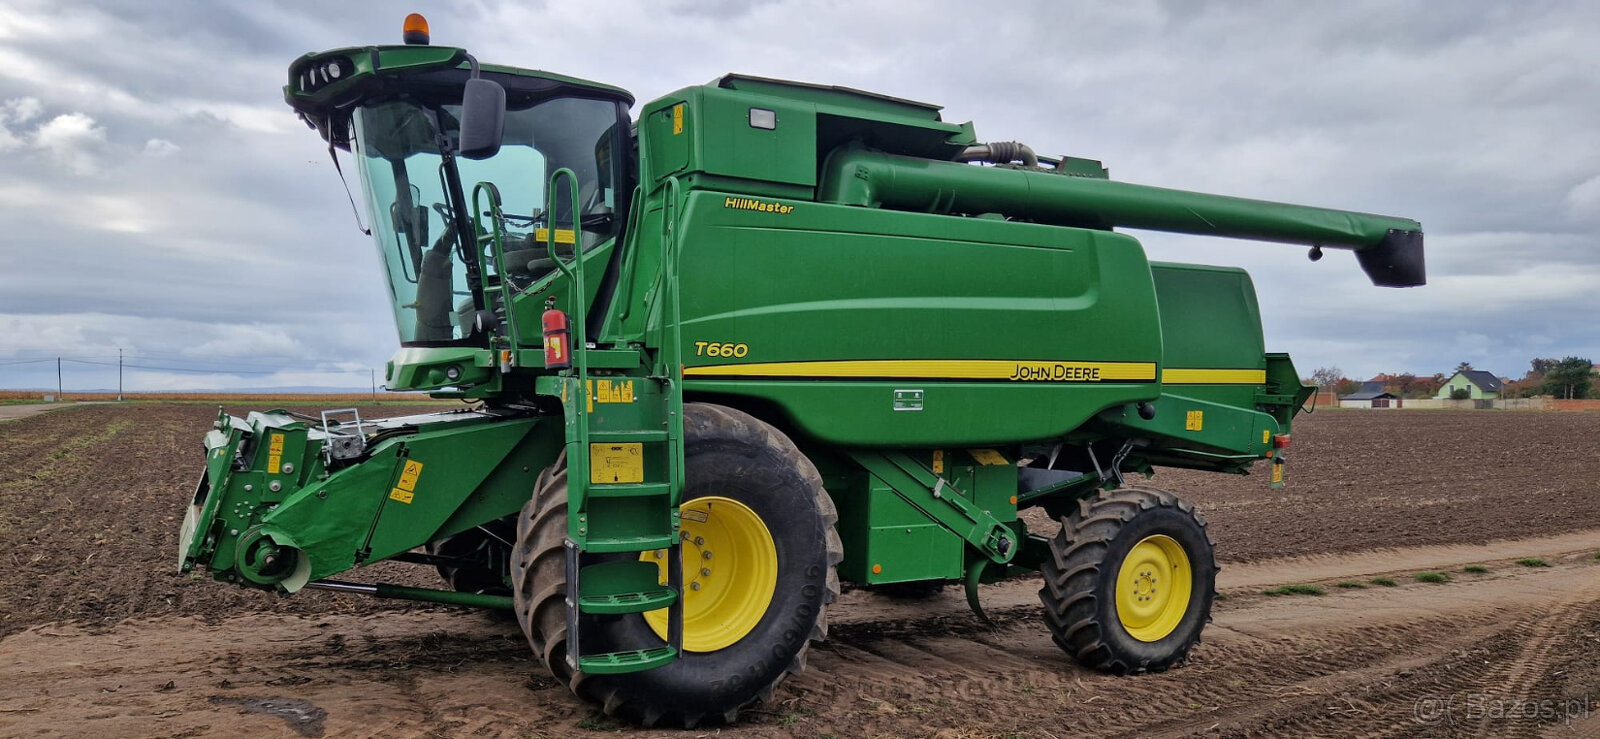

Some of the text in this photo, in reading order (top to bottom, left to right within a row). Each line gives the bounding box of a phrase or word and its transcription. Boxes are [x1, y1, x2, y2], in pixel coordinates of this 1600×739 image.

[724, 197, 794, 214] HillMaster
[695, 341, 749, 358] T660
[1010, 364, 1100, 379] JOHN DEERE
[773, 564, 820, 660] 900/60
